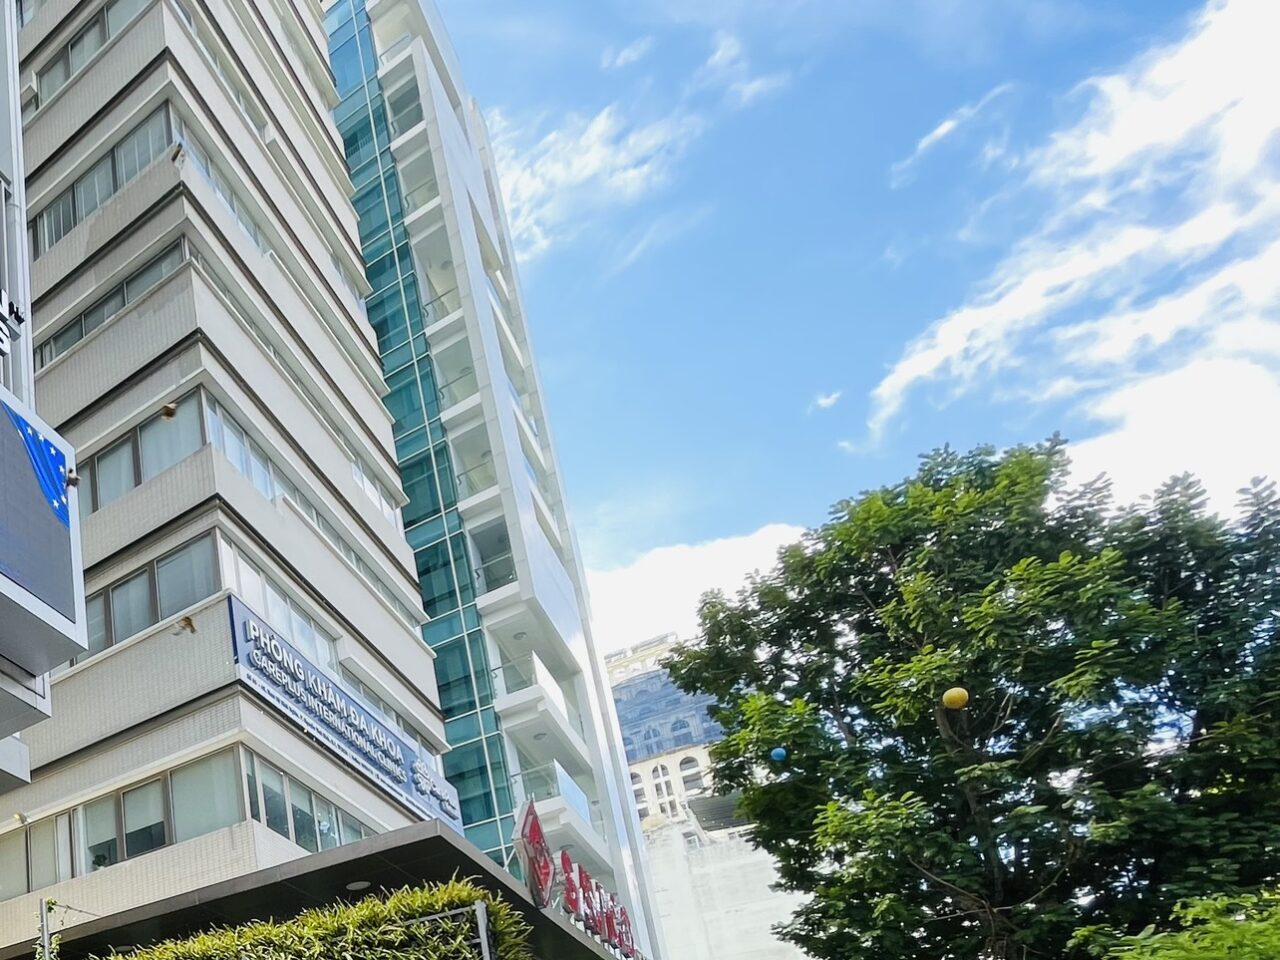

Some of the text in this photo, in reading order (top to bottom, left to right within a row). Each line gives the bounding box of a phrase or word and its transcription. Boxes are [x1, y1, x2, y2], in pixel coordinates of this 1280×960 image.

[249, 650, 306, 703] CAREPLUS
[349, 705, 369, 736] ĐA
[371, 724, 405, 765] KHOA
